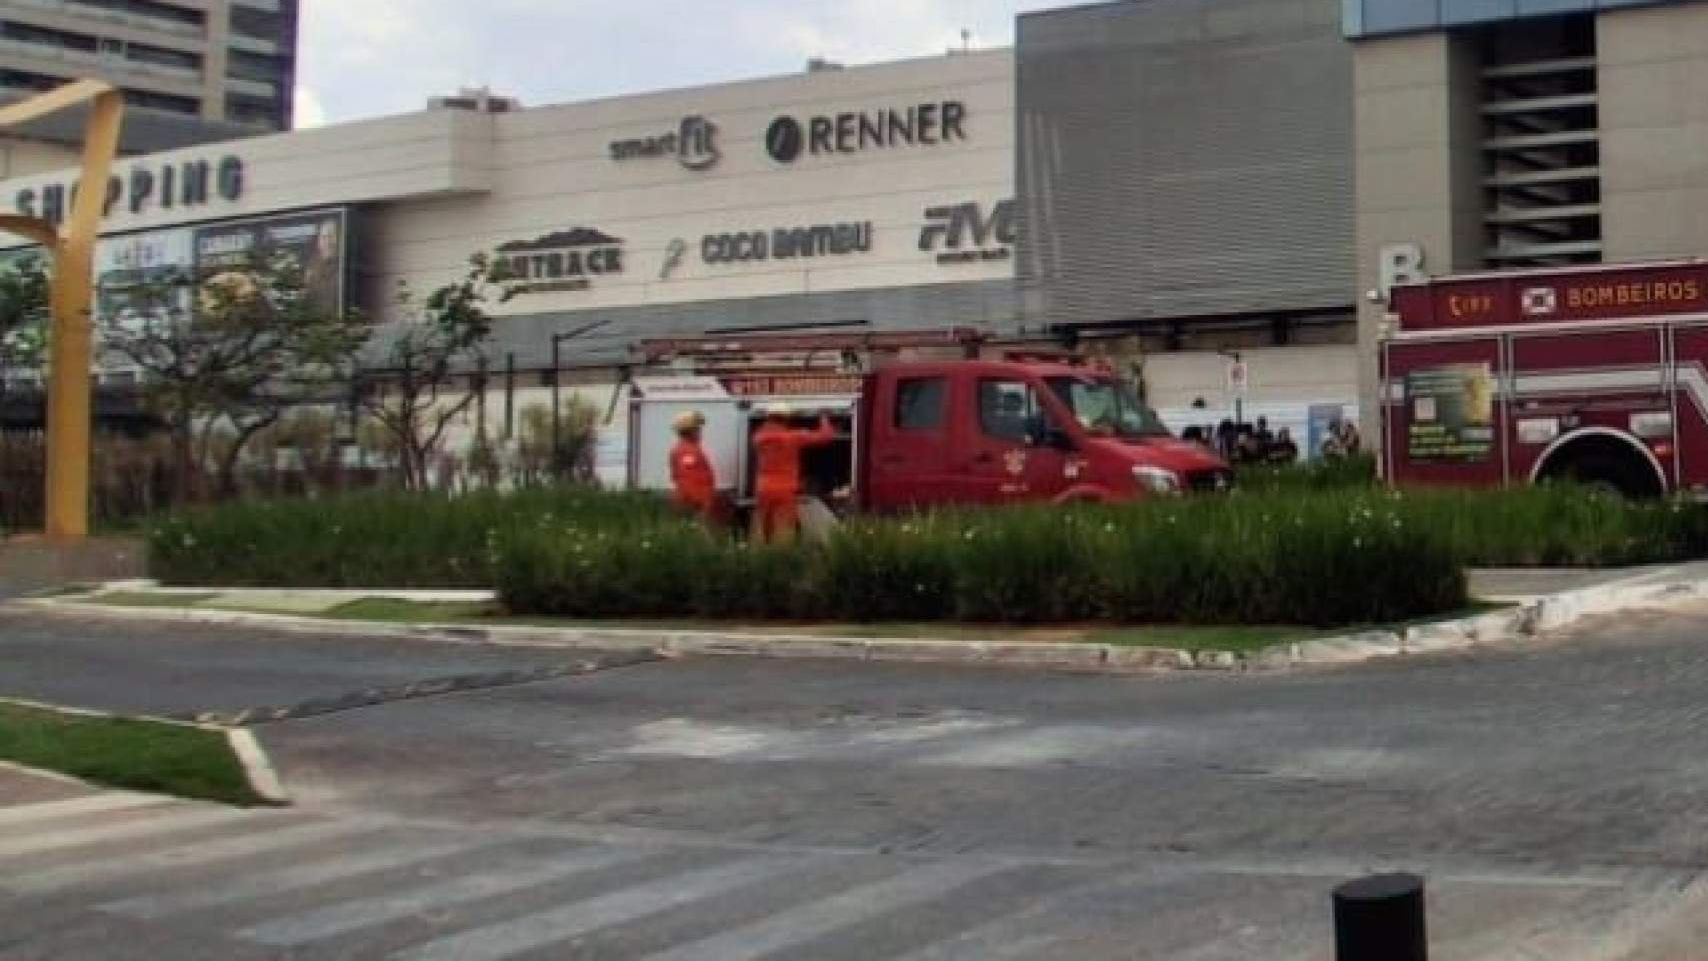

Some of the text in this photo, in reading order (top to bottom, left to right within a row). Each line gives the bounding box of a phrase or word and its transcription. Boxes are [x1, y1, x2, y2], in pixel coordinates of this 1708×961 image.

[809, 100, 967, 154] RENNER
[16, 154, 244, 225] SHPPING
[1567, 280, 1699, 309] BOMBEIROS
